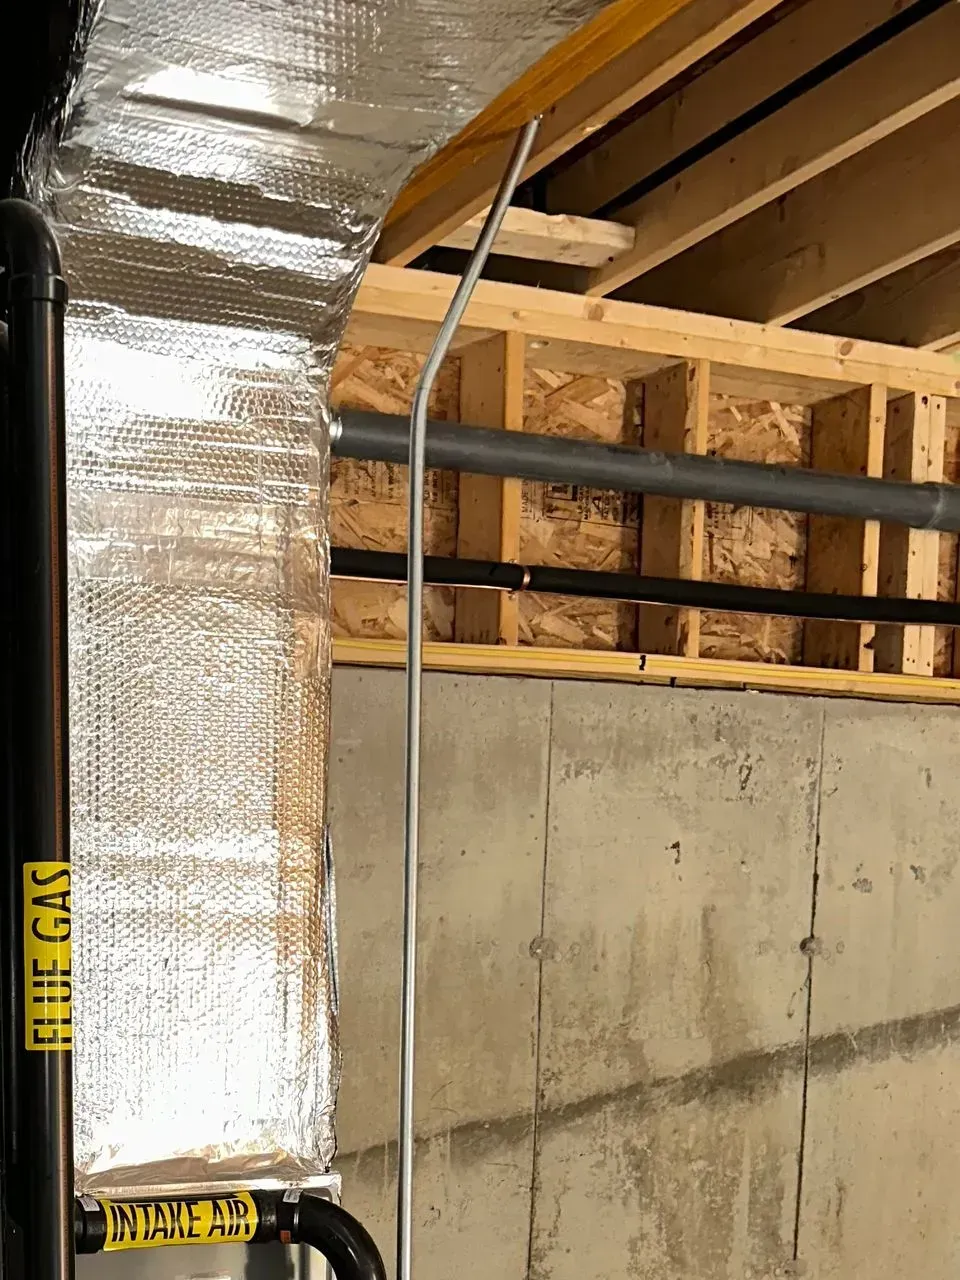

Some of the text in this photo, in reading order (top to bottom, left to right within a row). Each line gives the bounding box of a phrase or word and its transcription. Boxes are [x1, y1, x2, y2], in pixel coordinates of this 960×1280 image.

[30, 868, 72, 1045] FLUE GAS
[110, 1199, 251, 1242] INTAKE AIR
